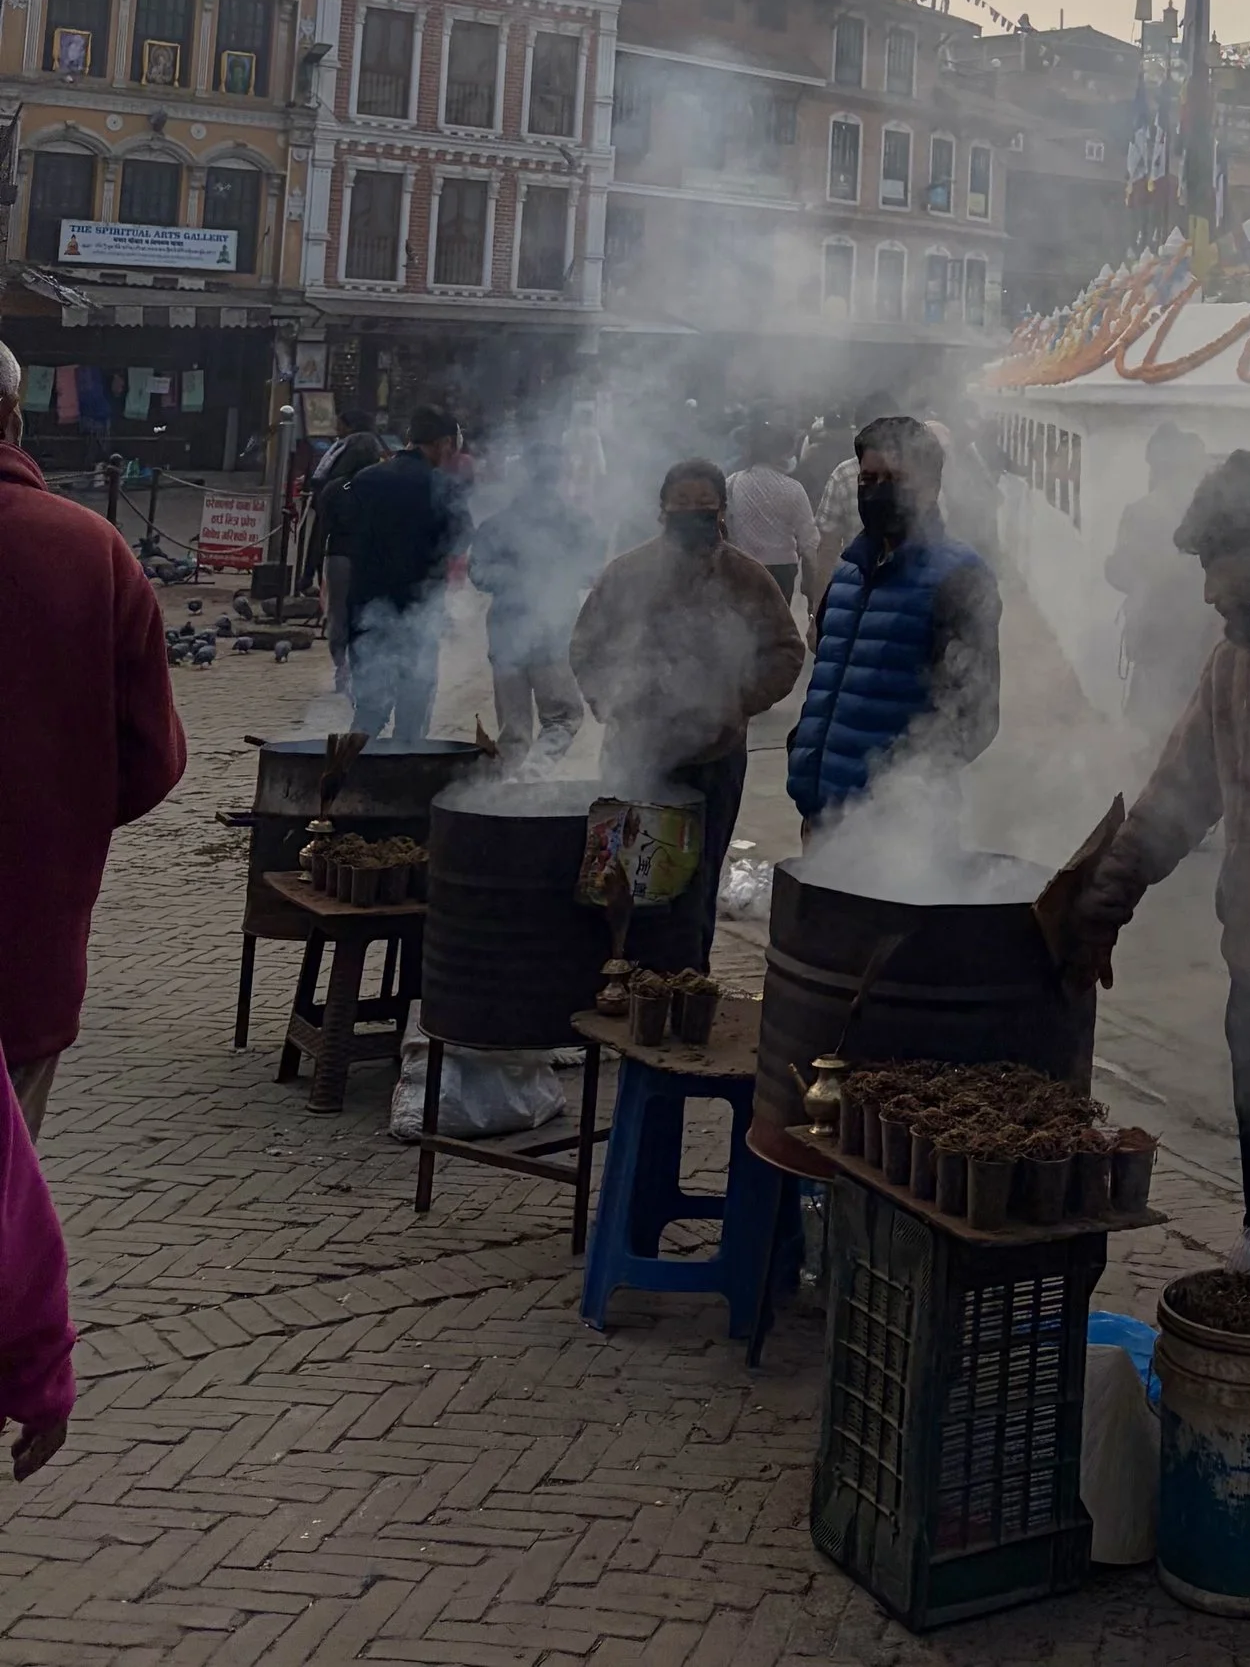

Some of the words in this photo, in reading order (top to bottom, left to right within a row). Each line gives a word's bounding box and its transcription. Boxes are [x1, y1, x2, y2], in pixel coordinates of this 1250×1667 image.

[70, 225, 92, 234] THE
[95, 226, 150, 236] SPIRITUAL
[153, 230, 181, 239] ARTS
[183, 232, 229, 243] GALLERY
